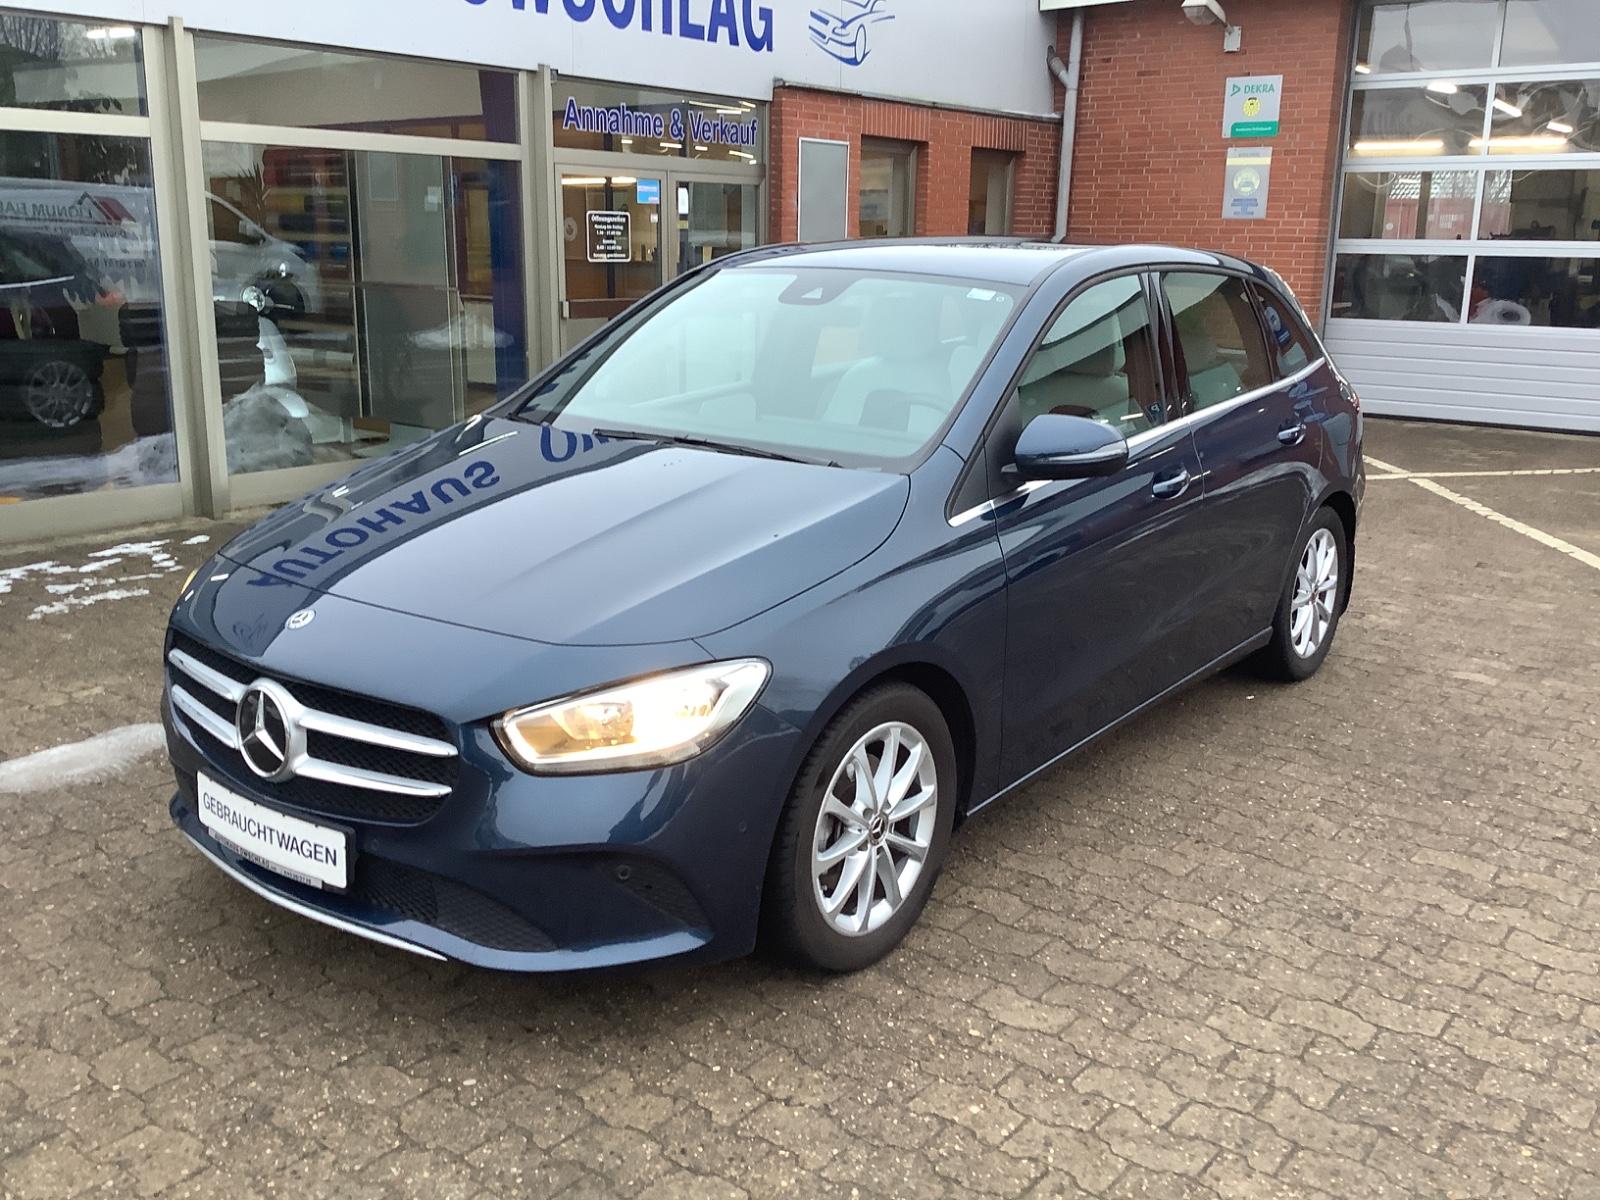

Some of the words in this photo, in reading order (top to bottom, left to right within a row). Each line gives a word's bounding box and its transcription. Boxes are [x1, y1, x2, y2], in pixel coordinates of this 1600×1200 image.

[1244, 84, 1275, 94] DEKRA
[562, 96, 664, 137] Annahme
[669, 108, 685, 140] &
[688, 110, 758, 145] Verkauf
[203, 792, 337, 867] GEBRAUCHTWAGEN
